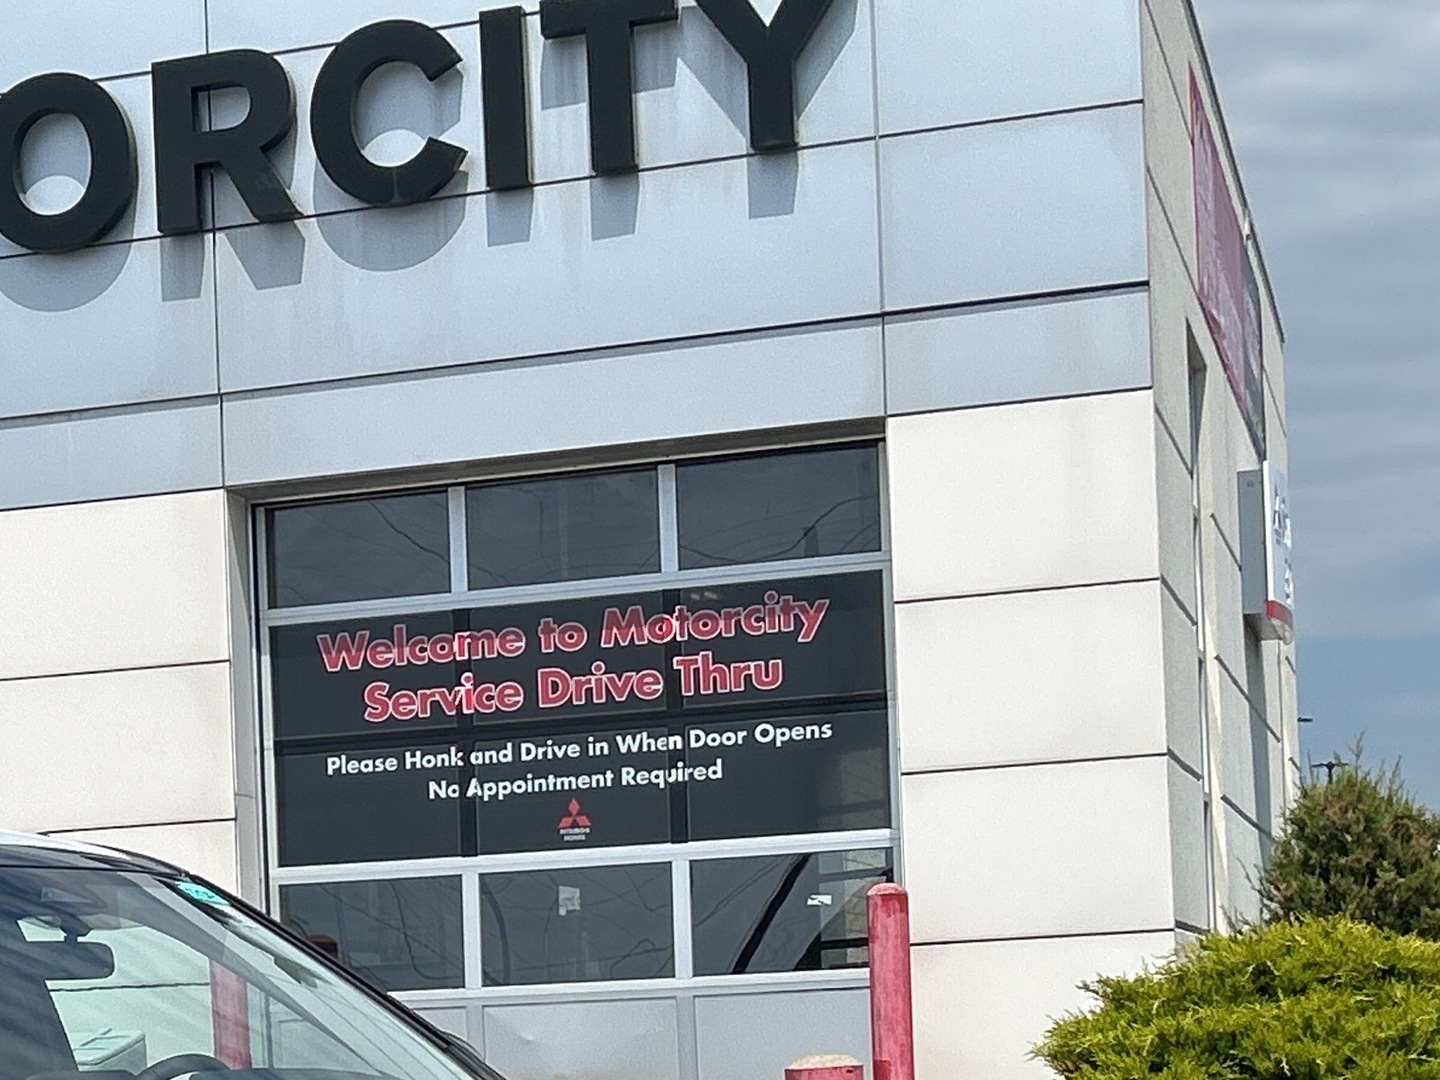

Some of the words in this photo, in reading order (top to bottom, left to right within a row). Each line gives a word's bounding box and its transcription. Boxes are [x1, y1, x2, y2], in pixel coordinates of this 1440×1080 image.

[316, 624, 525, 672] Welcome
[538, 617, 587, 652] to
[601, 591, 829, 647] Motorcity
[364, 672, 524, 722] Service
[537, 661, 663, 707] Drive
[673, 651, 783, 696] Thru
[327, 754, 398, 775] Please
[405, 747, 464, 769] Honk
[470, 742, 512, 765] and
[520, 740, 580, 761] Drive
[588, 736, 609, 756] in
[616, 731, 682, 754] When
[689, 729, 747, 749] Door
[754, 722, 832, 747] Opens
[428, 781, 459, 800] No
[466, 770, 614, 801] Appointment
[621, 758, 723, 788] Required
